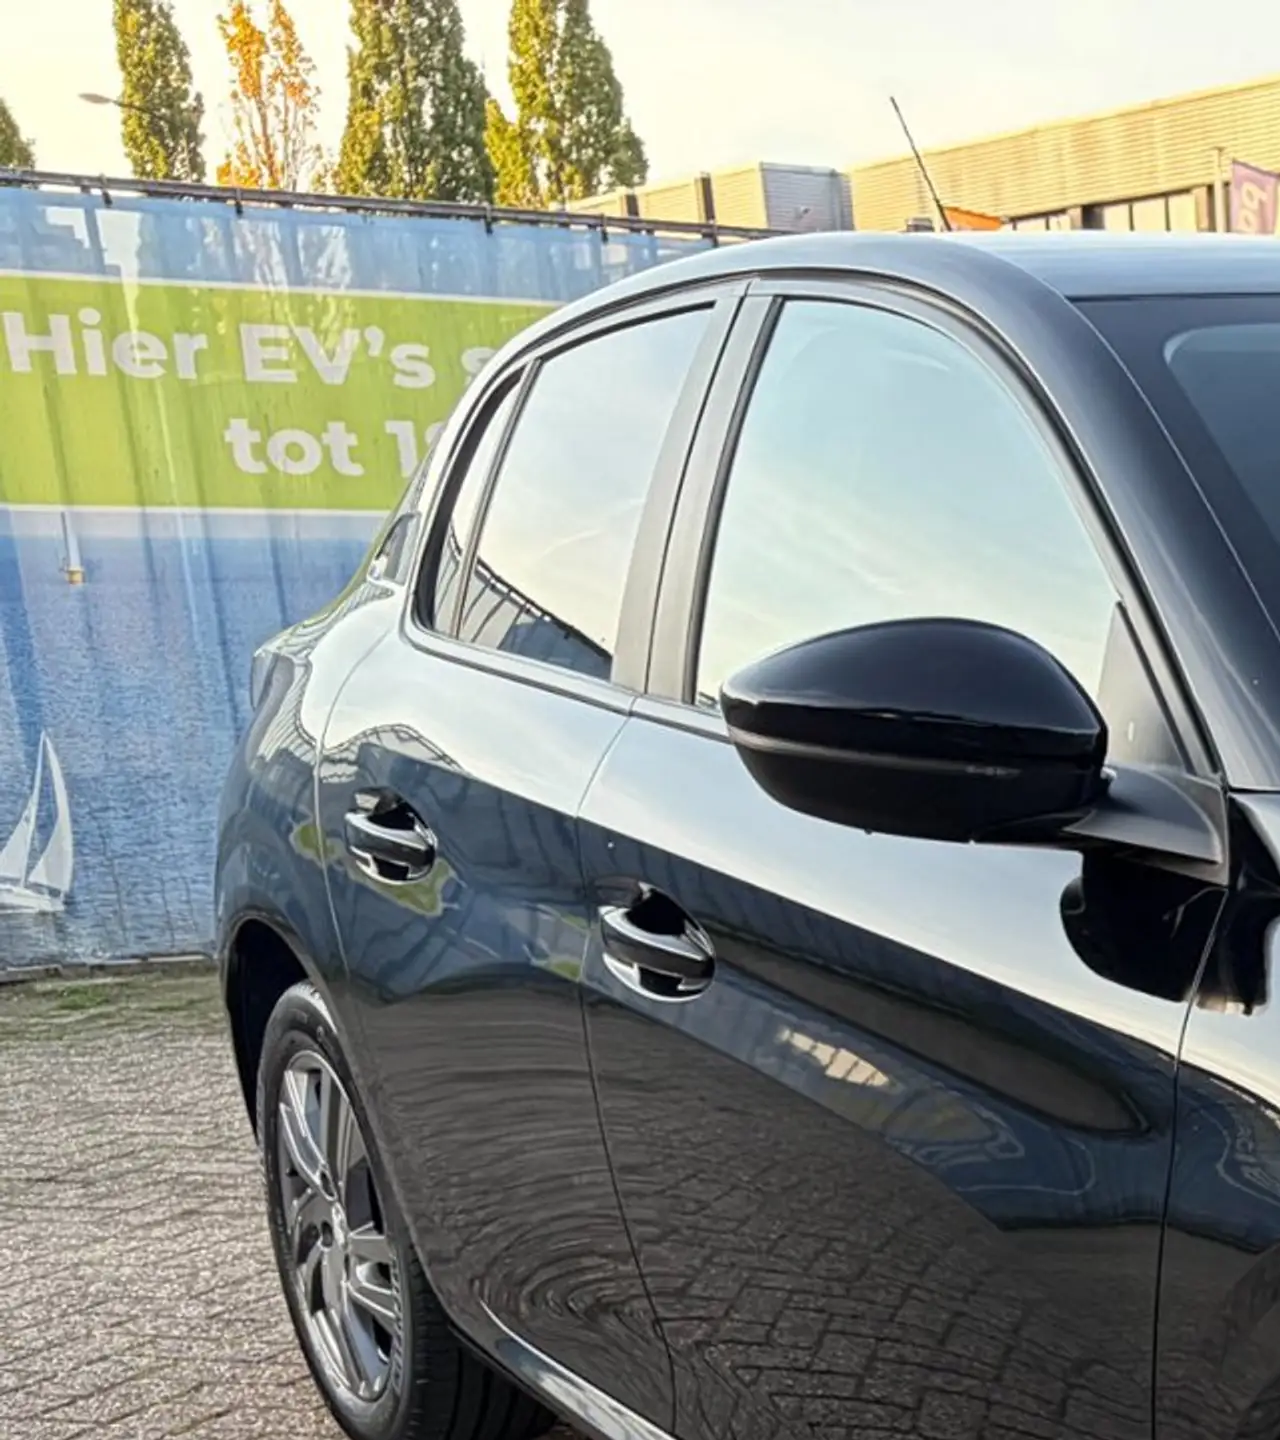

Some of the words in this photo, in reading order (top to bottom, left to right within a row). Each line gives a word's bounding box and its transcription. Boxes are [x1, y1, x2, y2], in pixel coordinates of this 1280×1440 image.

[2, 307, 208, 380] Hier
[239, 322, 436, 389] EV's
[224, 417, 365, 477] tot
[384, 419, 447, 478] 1
